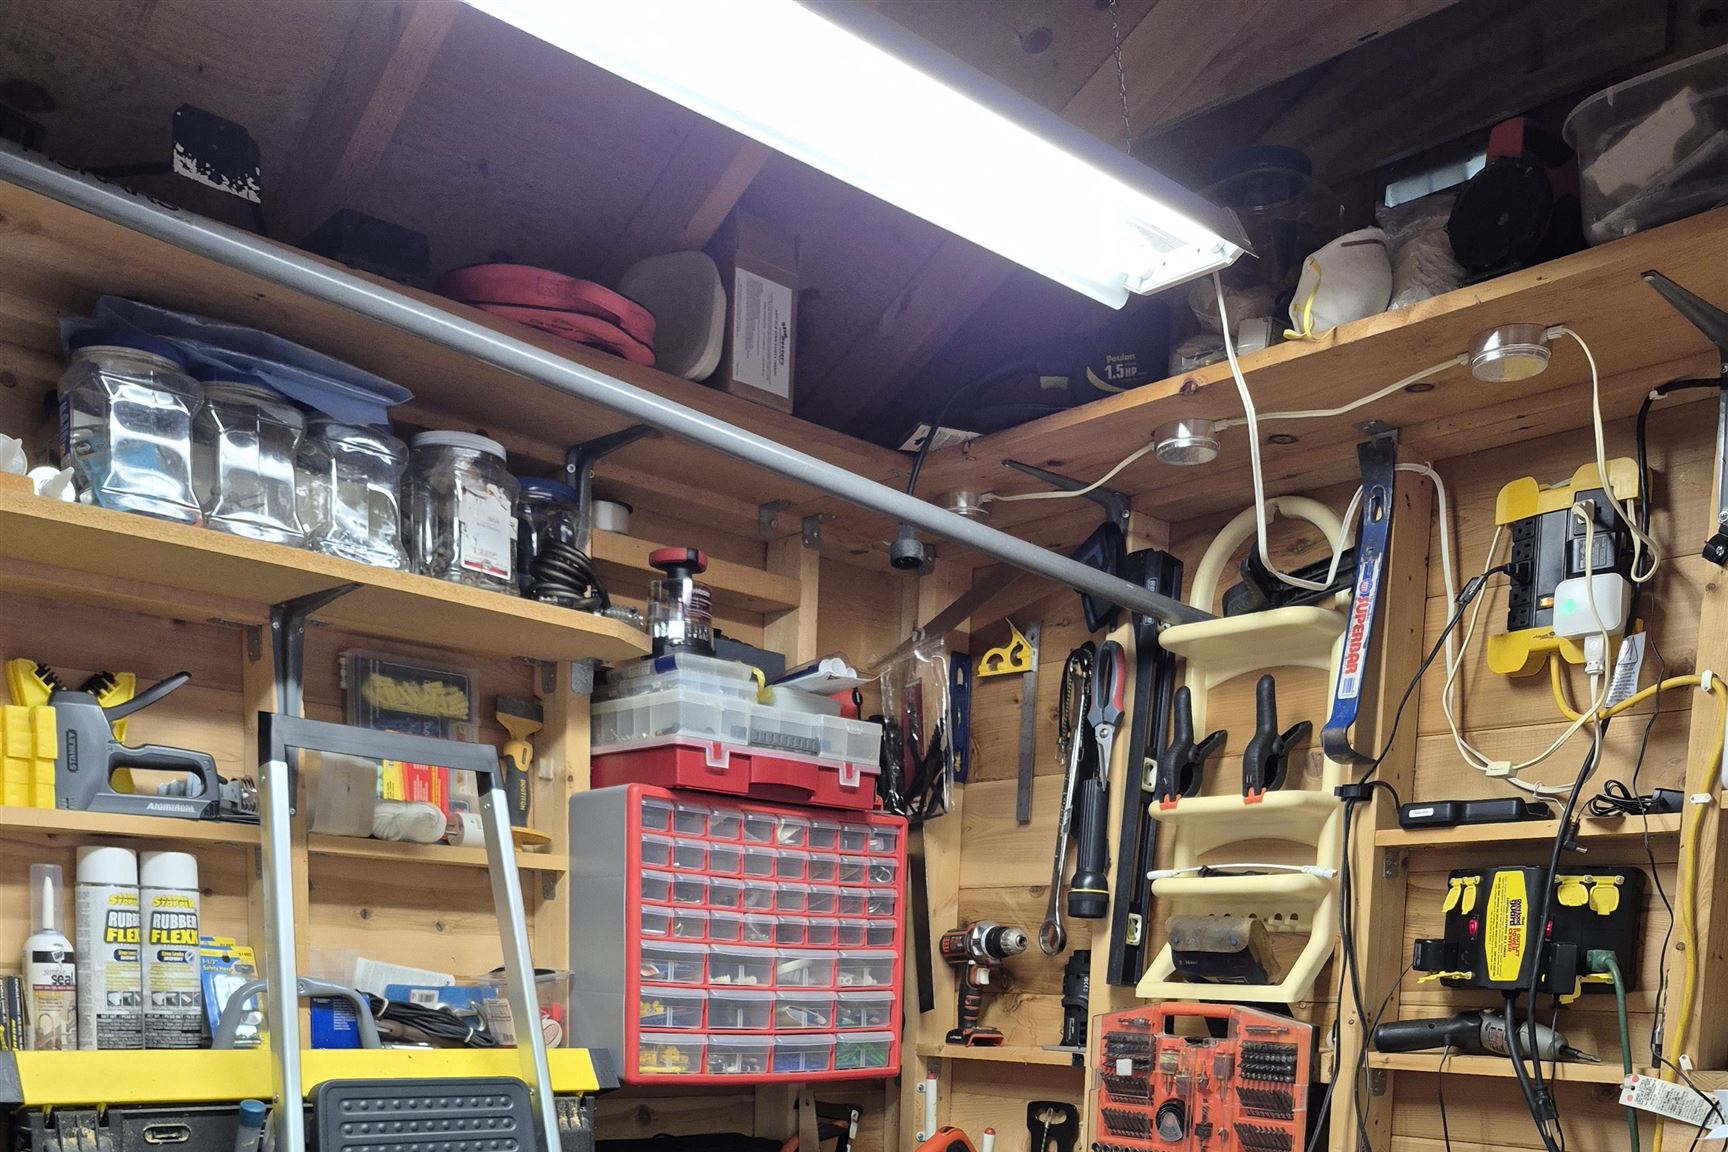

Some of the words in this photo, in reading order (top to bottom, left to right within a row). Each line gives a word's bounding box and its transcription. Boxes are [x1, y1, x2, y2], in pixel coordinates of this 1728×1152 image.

[1106, 353, 1136, 363] Poulan
[1105, 364, 1124, 379] 1.5
[1125, 367, 1138, 377] HP
[1344, 596, 1370, 675] SUPERBAR
[68, 730, 77, 772] STANLEY
[519, 778, 527, 811] BOSTITCH
[152, 913, 197, 929] RUBBER
[51, 970, 73, 986] seal
